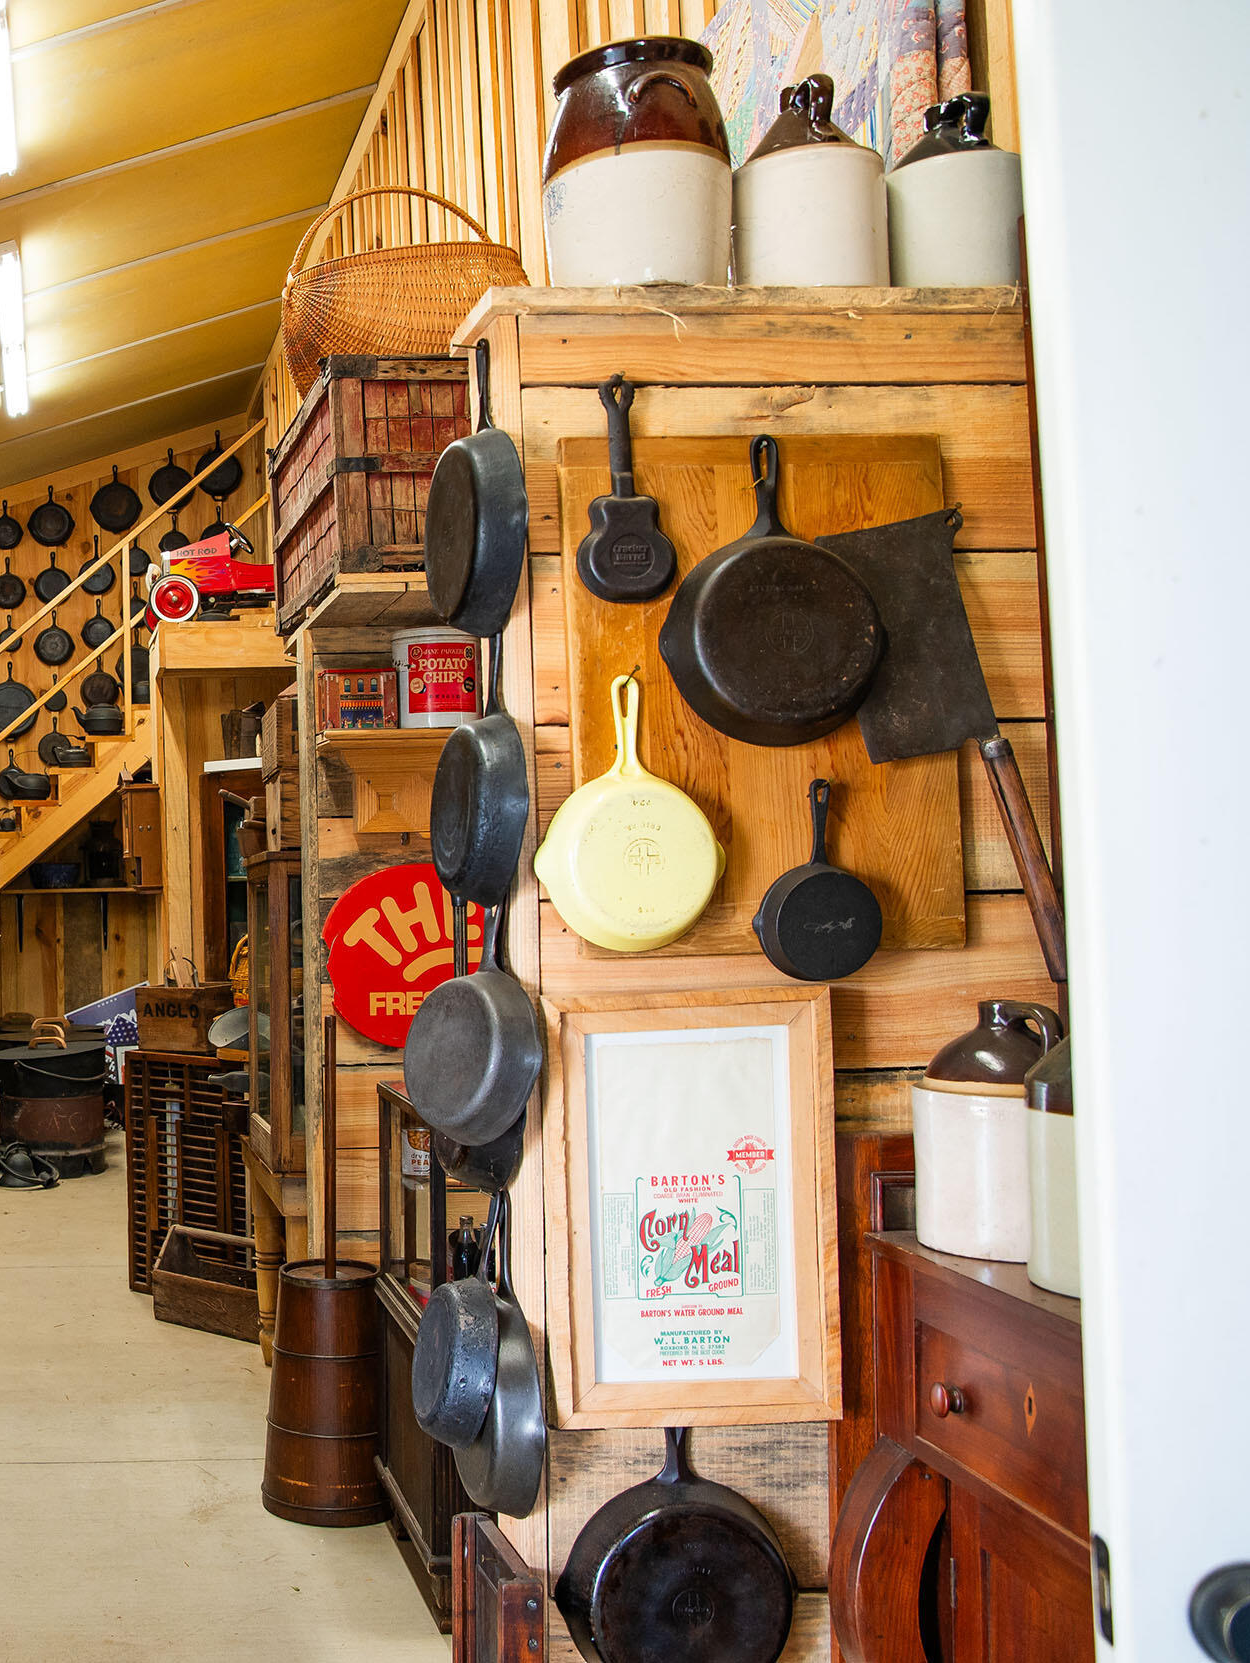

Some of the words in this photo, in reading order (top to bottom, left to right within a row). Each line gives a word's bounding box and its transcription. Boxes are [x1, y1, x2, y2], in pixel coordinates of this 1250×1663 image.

[176, 548, 195, 557] HOT
[198, 547, 218, 555] ROD
[418, 658, 468, 671] POTATO
[423, 671, 465, 684] CHIPS
[369, 990, 432, 1016] FRE
[143, 1002, 199, 1018] ANGLO
[735, 1150, 765, 1159] MEMBER
[651, 1174, 725, 1187] BARTON'S
[639, 1208, 690, 1252] Corn
[684, 1240, 740, 1288] Meal
[708, 1278, 739, 1292] GROUND
[646, 1286, 672, 1298] FRESH
[640, 1309, 672, 1318] BARTON'S
[674, 1308, 696, 1317] WATER
[698, 1308, 725, 1316] GROUND
[727, 1307, 744, 1315] MEAL
[654, 1337, 669, 1345] W.
[671, 1336, 681, 1345] L.
[683, 1335, 731, 1344] BARTON
